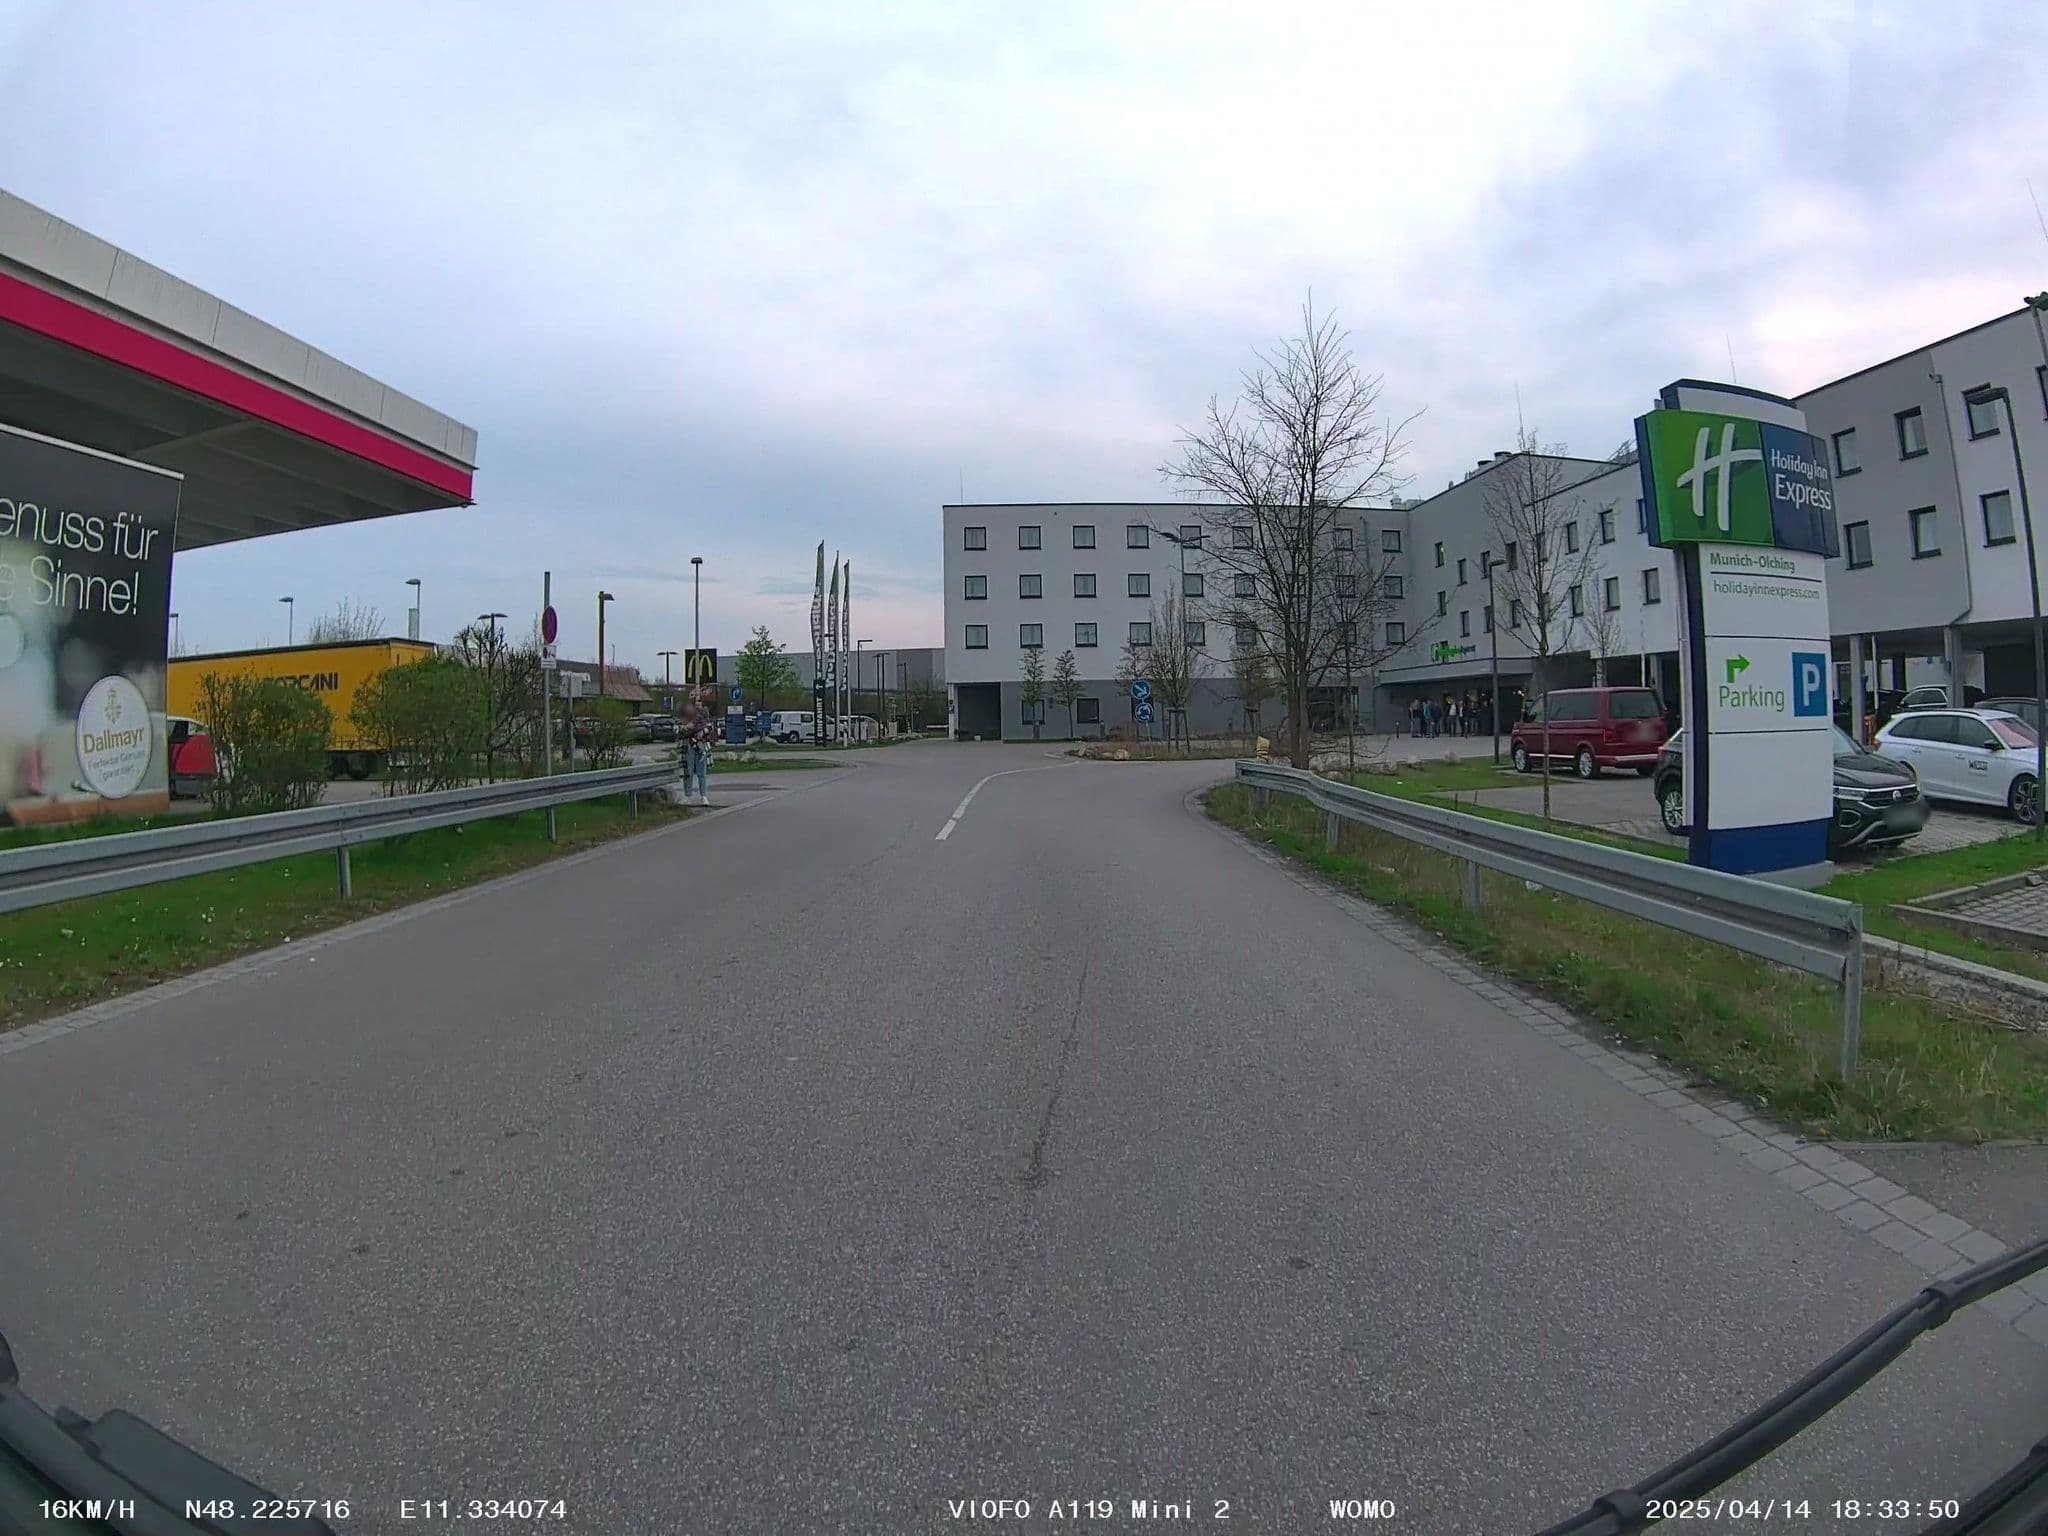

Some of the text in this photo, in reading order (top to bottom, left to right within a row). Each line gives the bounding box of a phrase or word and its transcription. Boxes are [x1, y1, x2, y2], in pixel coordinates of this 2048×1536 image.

[1775, 473, 1832, 510] Express
[113, 511, 159, 561] für
[1710, 553, 1796, 573] Munich-Olching
[30, 555, 139, 616] Sinne!
[1713, 580, 1820, 599] holidayinnexpress.com
[1719, 684, 1785, 712] Parking
[1802, 662, 1821, 707] P
[83, 727, 144, 754] Dallmayr
